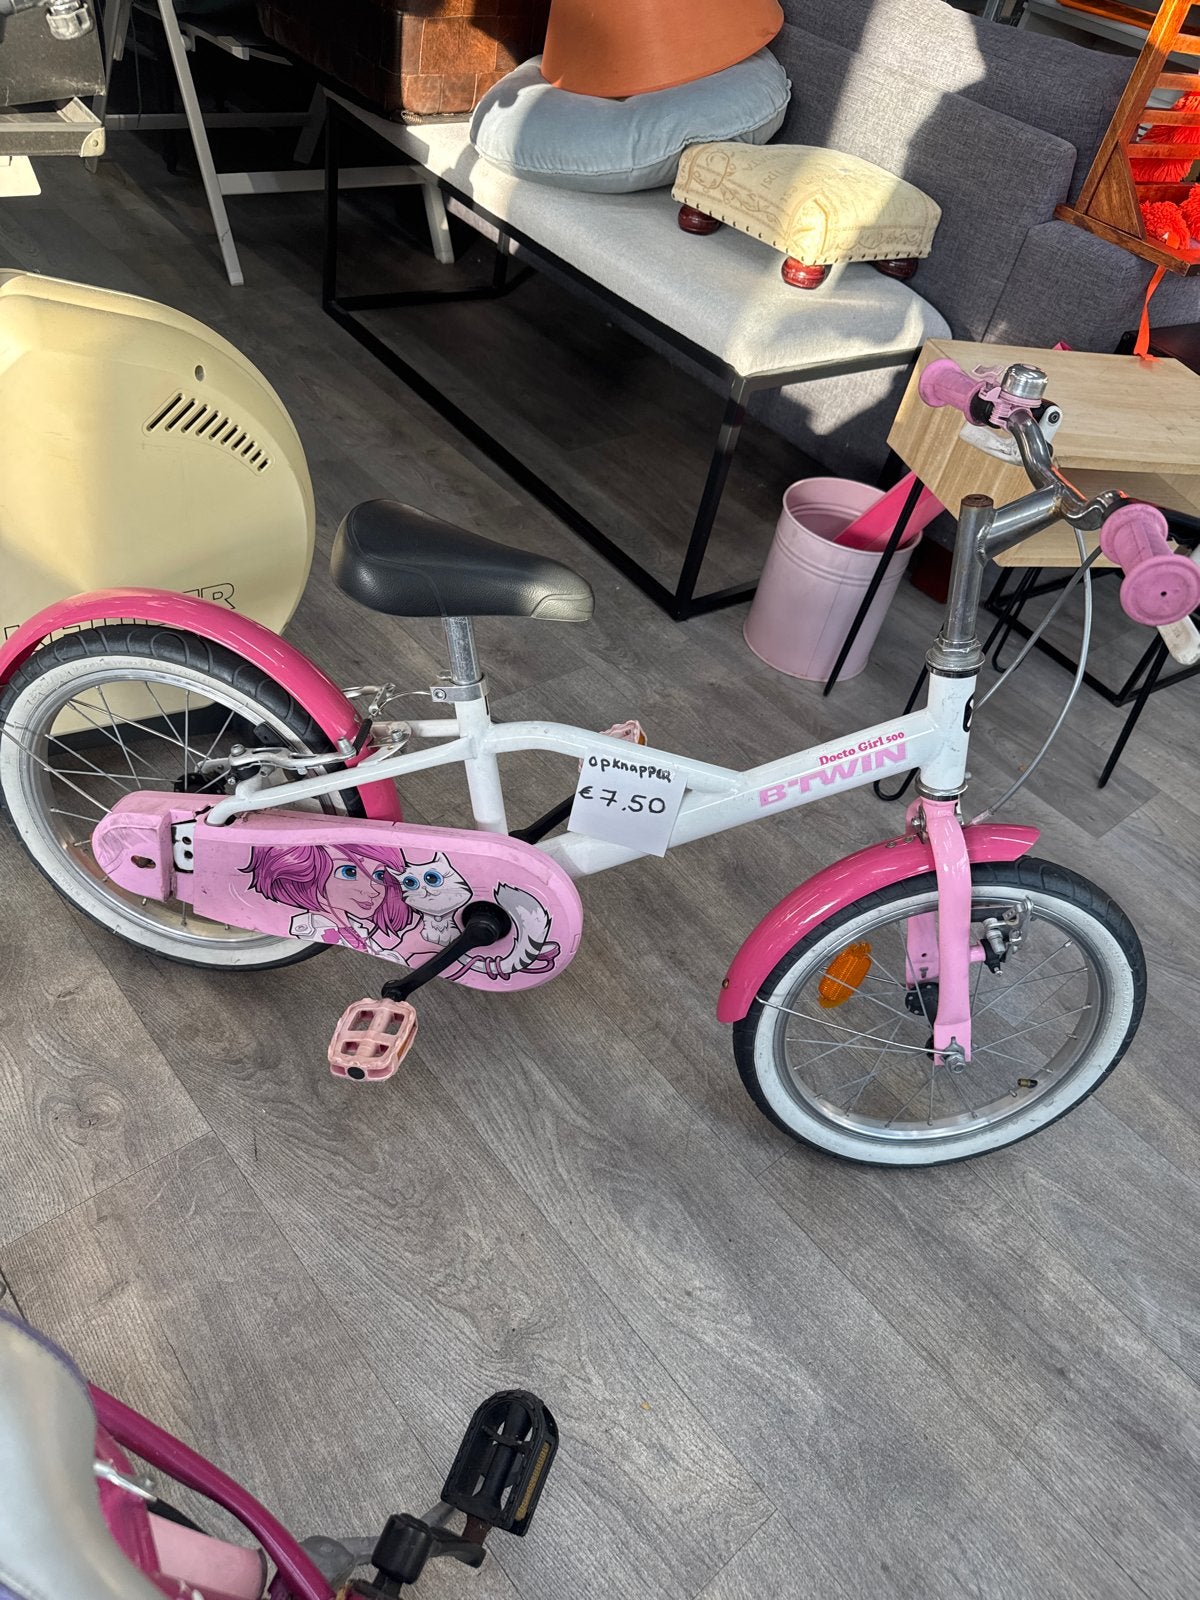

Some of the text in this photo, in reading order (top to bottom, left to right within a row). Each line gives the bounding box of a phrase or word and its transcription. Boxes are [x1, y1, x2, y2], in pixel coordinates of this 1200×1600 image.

[819, 731, 905, 766] Docto Girl 500
